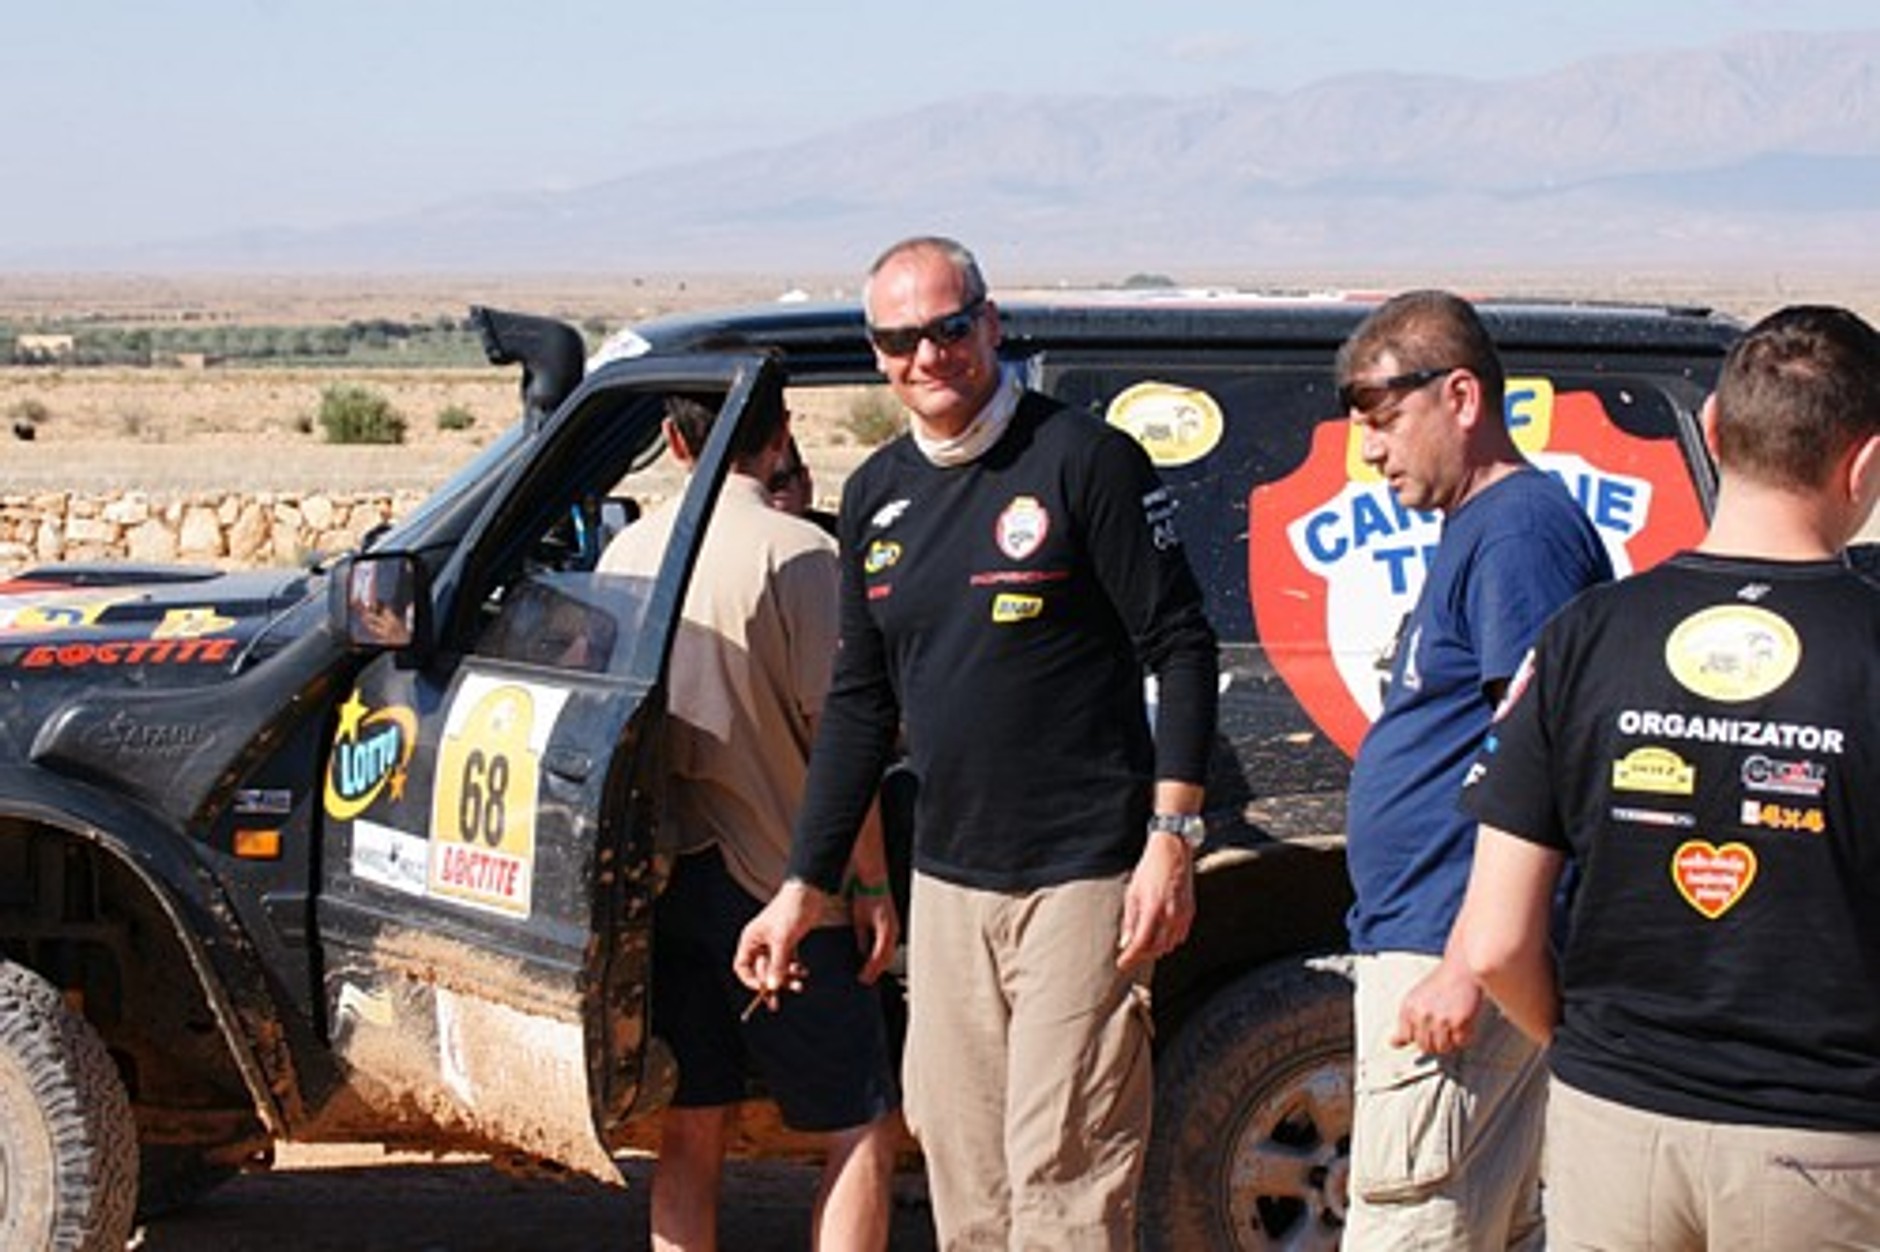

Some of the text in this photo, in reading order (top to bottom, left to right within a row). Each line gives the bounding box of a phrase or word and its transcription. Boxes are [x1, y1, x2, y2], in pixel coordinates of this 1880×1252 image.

[22, 639, 237, 667] LOCTITE
[1618, 710, 1844, 753] ORGANIZATOR
[341, 725, 399, 795] LOTTO
[460, 748, 509, 848] 68
[441, 847, 520, 896] LOCTITE
